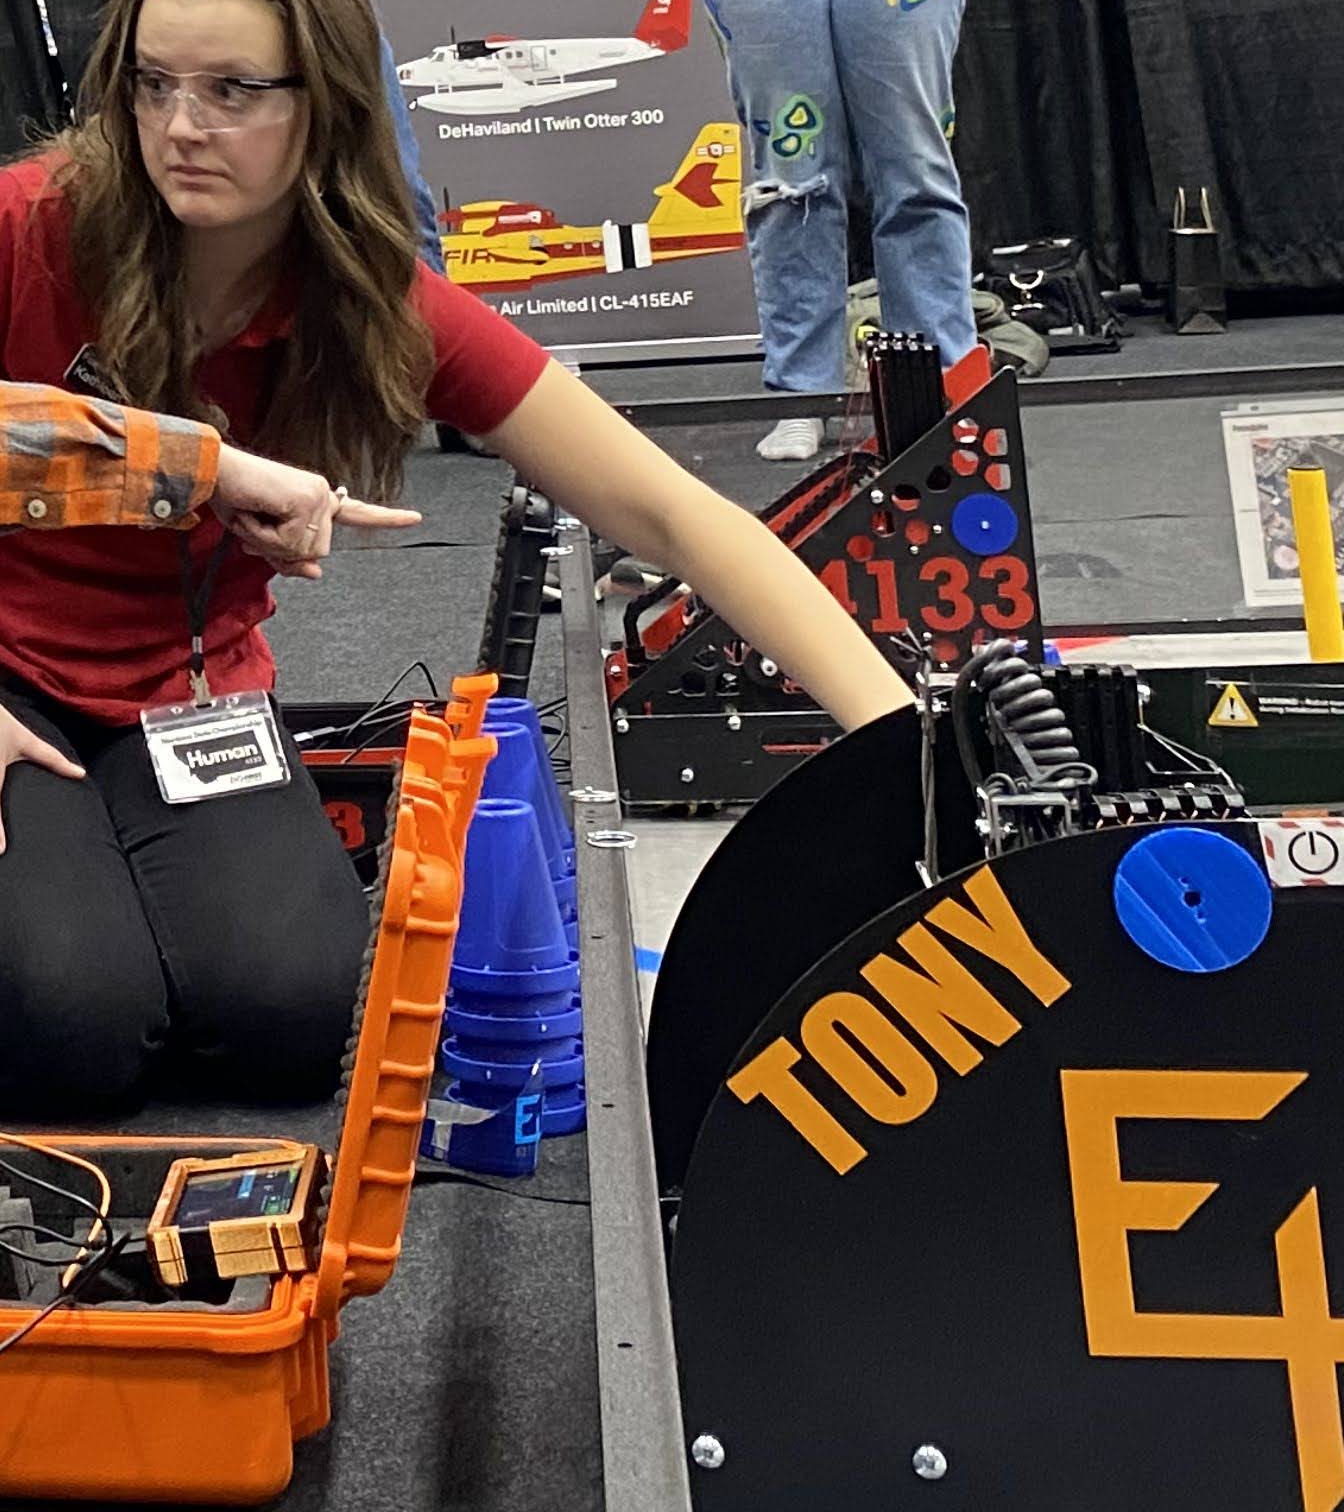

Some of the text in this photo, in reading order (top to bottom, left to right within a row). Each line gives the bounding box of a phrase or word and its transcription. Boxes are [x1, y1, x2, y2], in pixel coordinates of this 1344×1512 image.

[438, 109, 664, 140] DeHaviland Twin Otter 300
[500, 300, 523, 316] Air
[526, 296, 589, 315] Limited
[599, 291, 694, 311] CL-415EAF
[186, 743, 259, 769] Human
[725, 864, 1072, 1176] TONY
